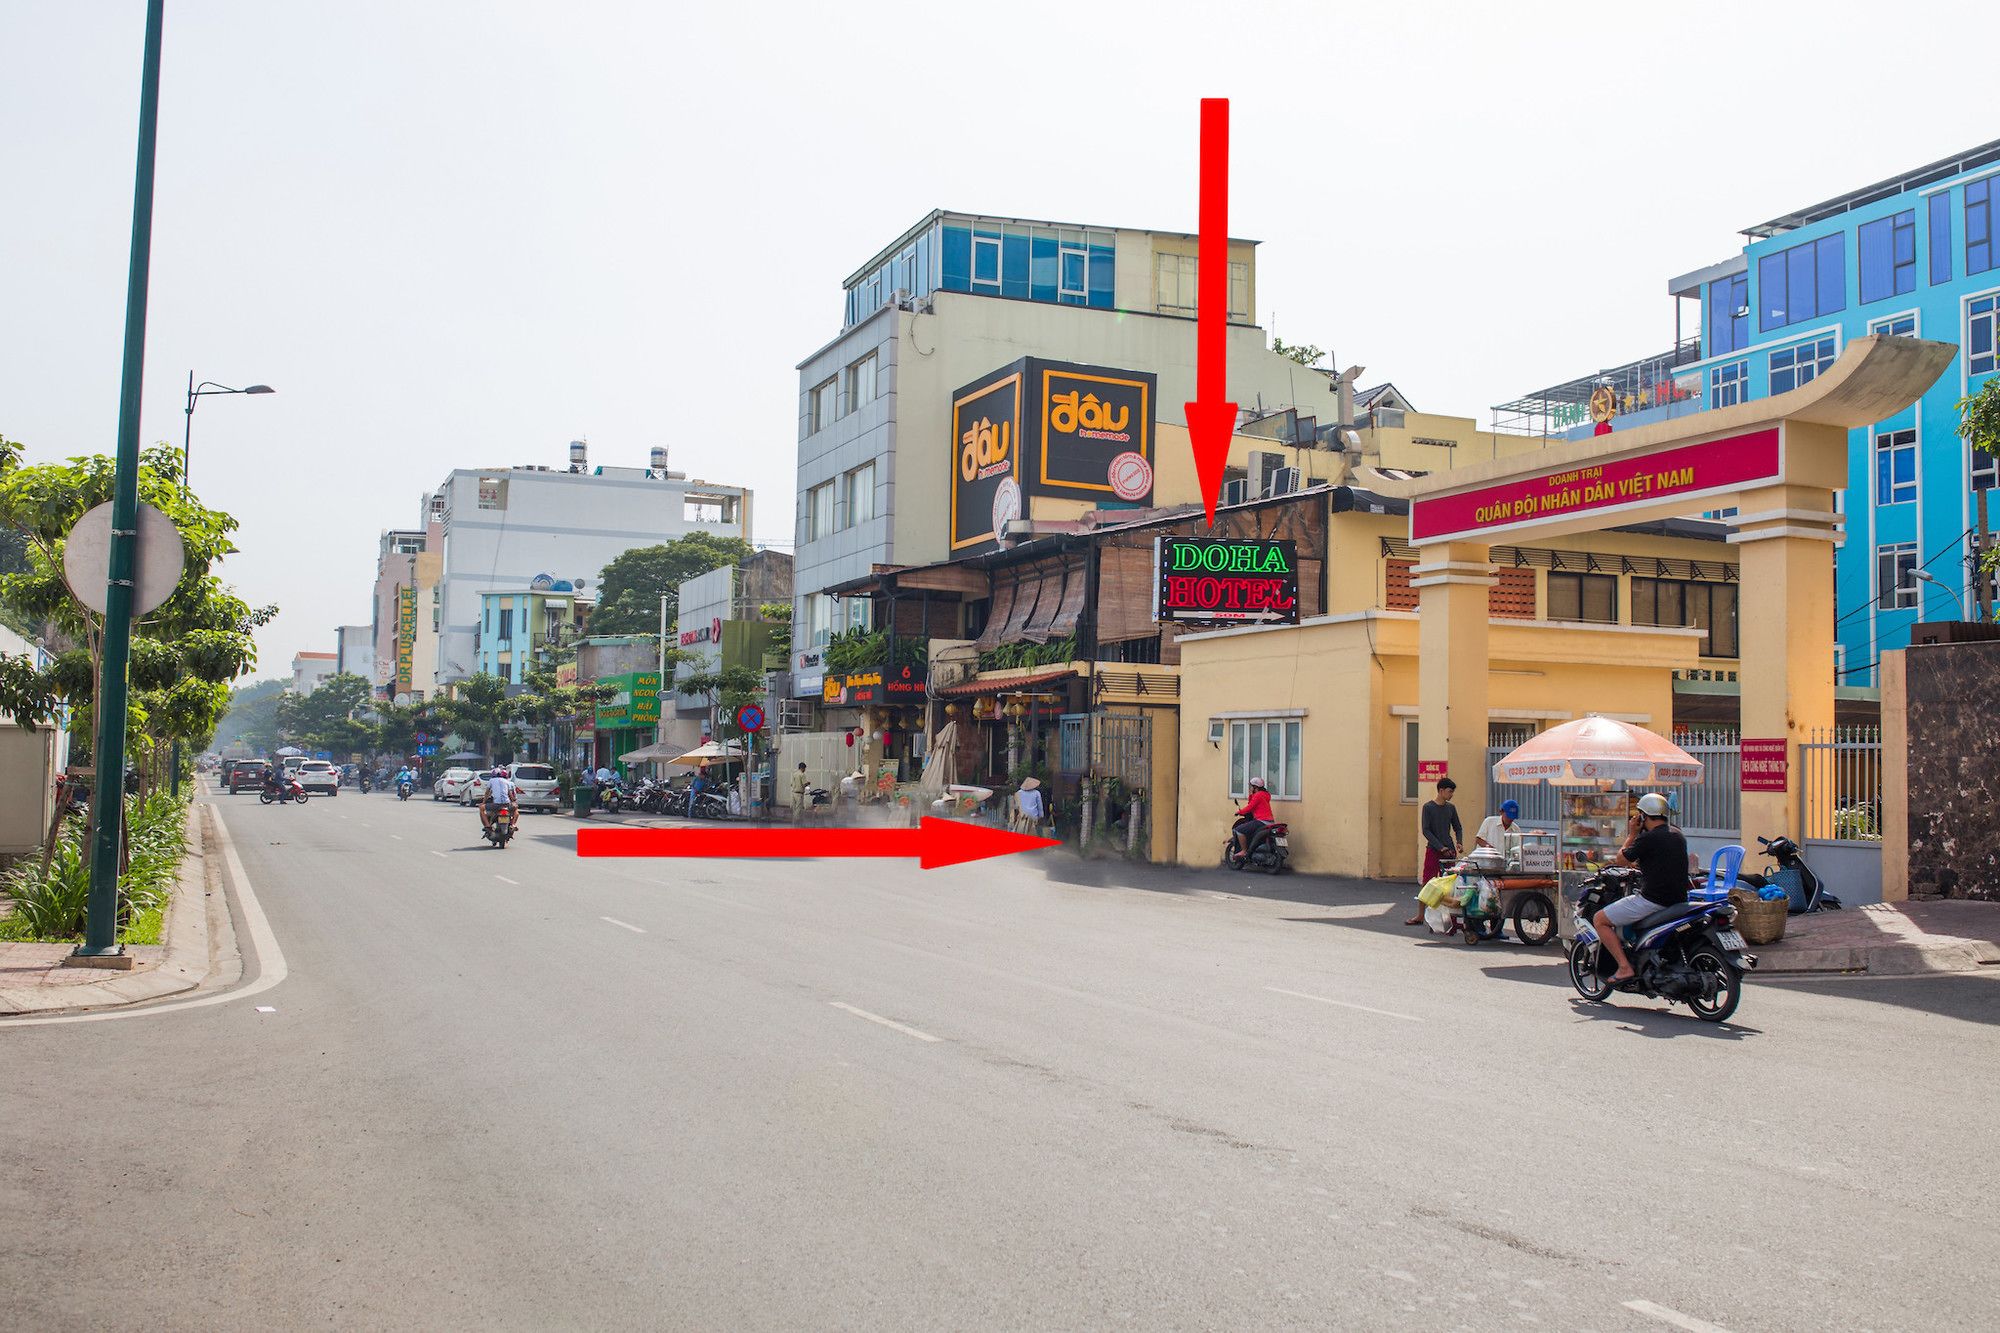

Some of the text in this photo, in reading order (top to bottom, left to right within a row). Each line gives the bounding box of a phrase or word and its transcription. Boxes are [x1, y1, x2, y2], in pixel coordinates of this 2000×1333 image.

[1079, 428, 1131, 442] homemade
[978, 460, 1011, 480] homemade
[1549, 466, 1602, 487] DOANH TRẠI
[1475, 467, 1695, 523] QUÂN ĐỘI NHÂN DÂN VIỆT NAM
[1173, 543, 1290, 573] DOHA
[1167, 576, 1295, 609] HOTEL
[902, 666, 911, 678] 6
[634, 689, 657, 697] NGON
[1527, 766, 1539, 775] 222
[1539, 766, 1548, 774] 00
[1549, 764, 1562, 774] 919
